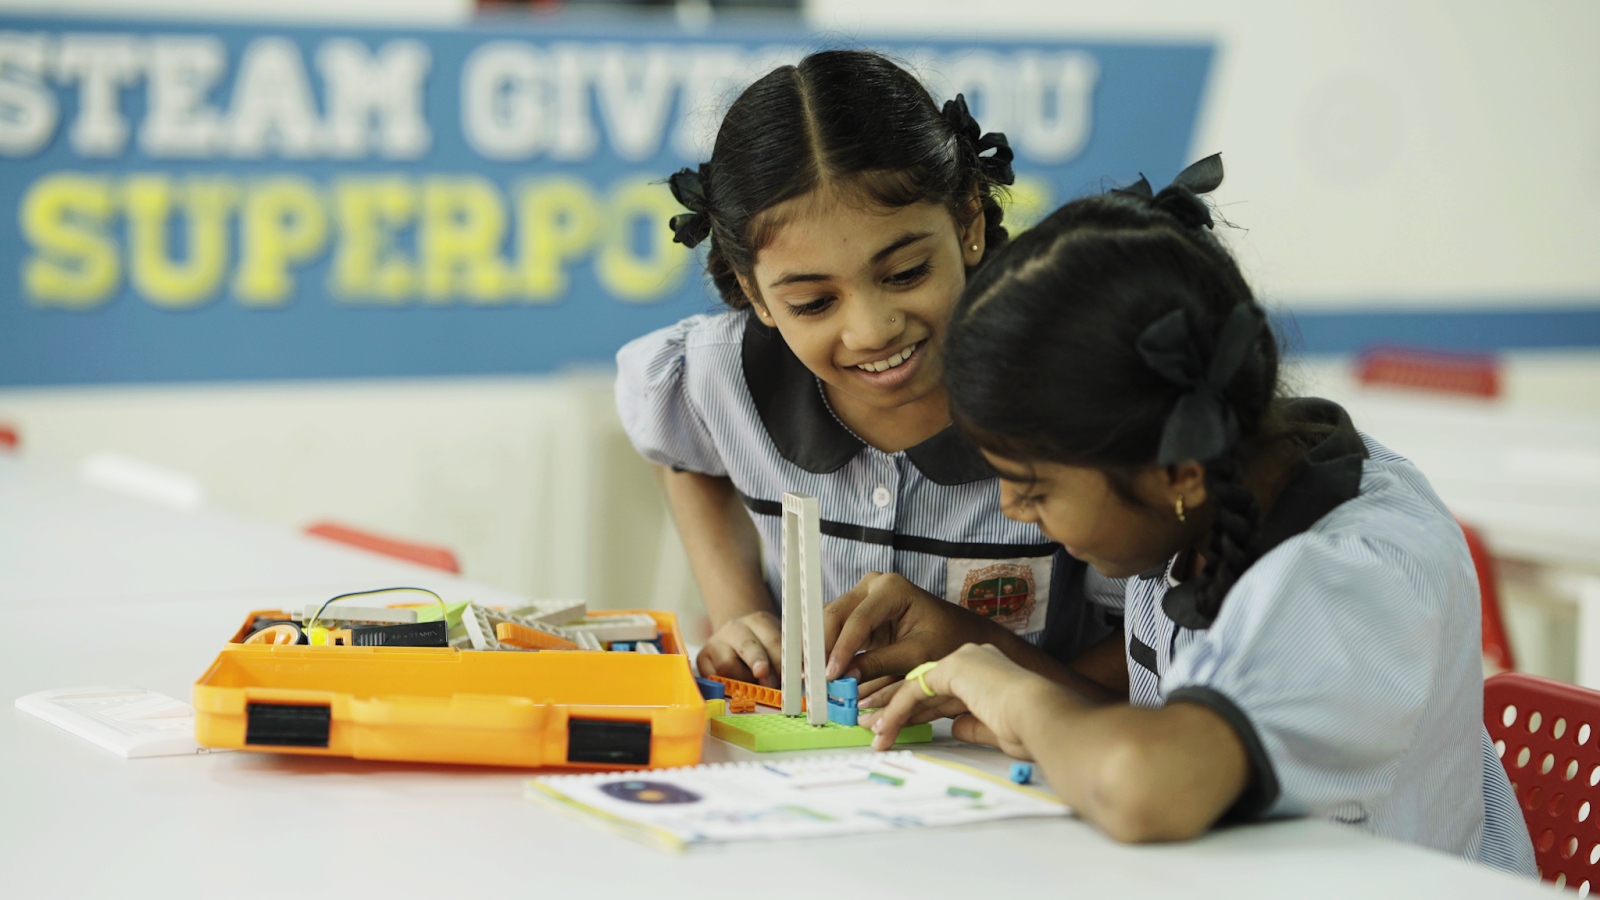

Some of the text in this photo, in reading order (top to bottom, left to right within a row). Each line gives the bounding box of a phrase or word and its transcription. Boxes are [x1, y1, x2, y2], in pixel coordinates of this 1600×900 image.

[0, 33, 1097, 163] STEAM GIVE OU
[20, 172, 1054, 306] SUPERPO
